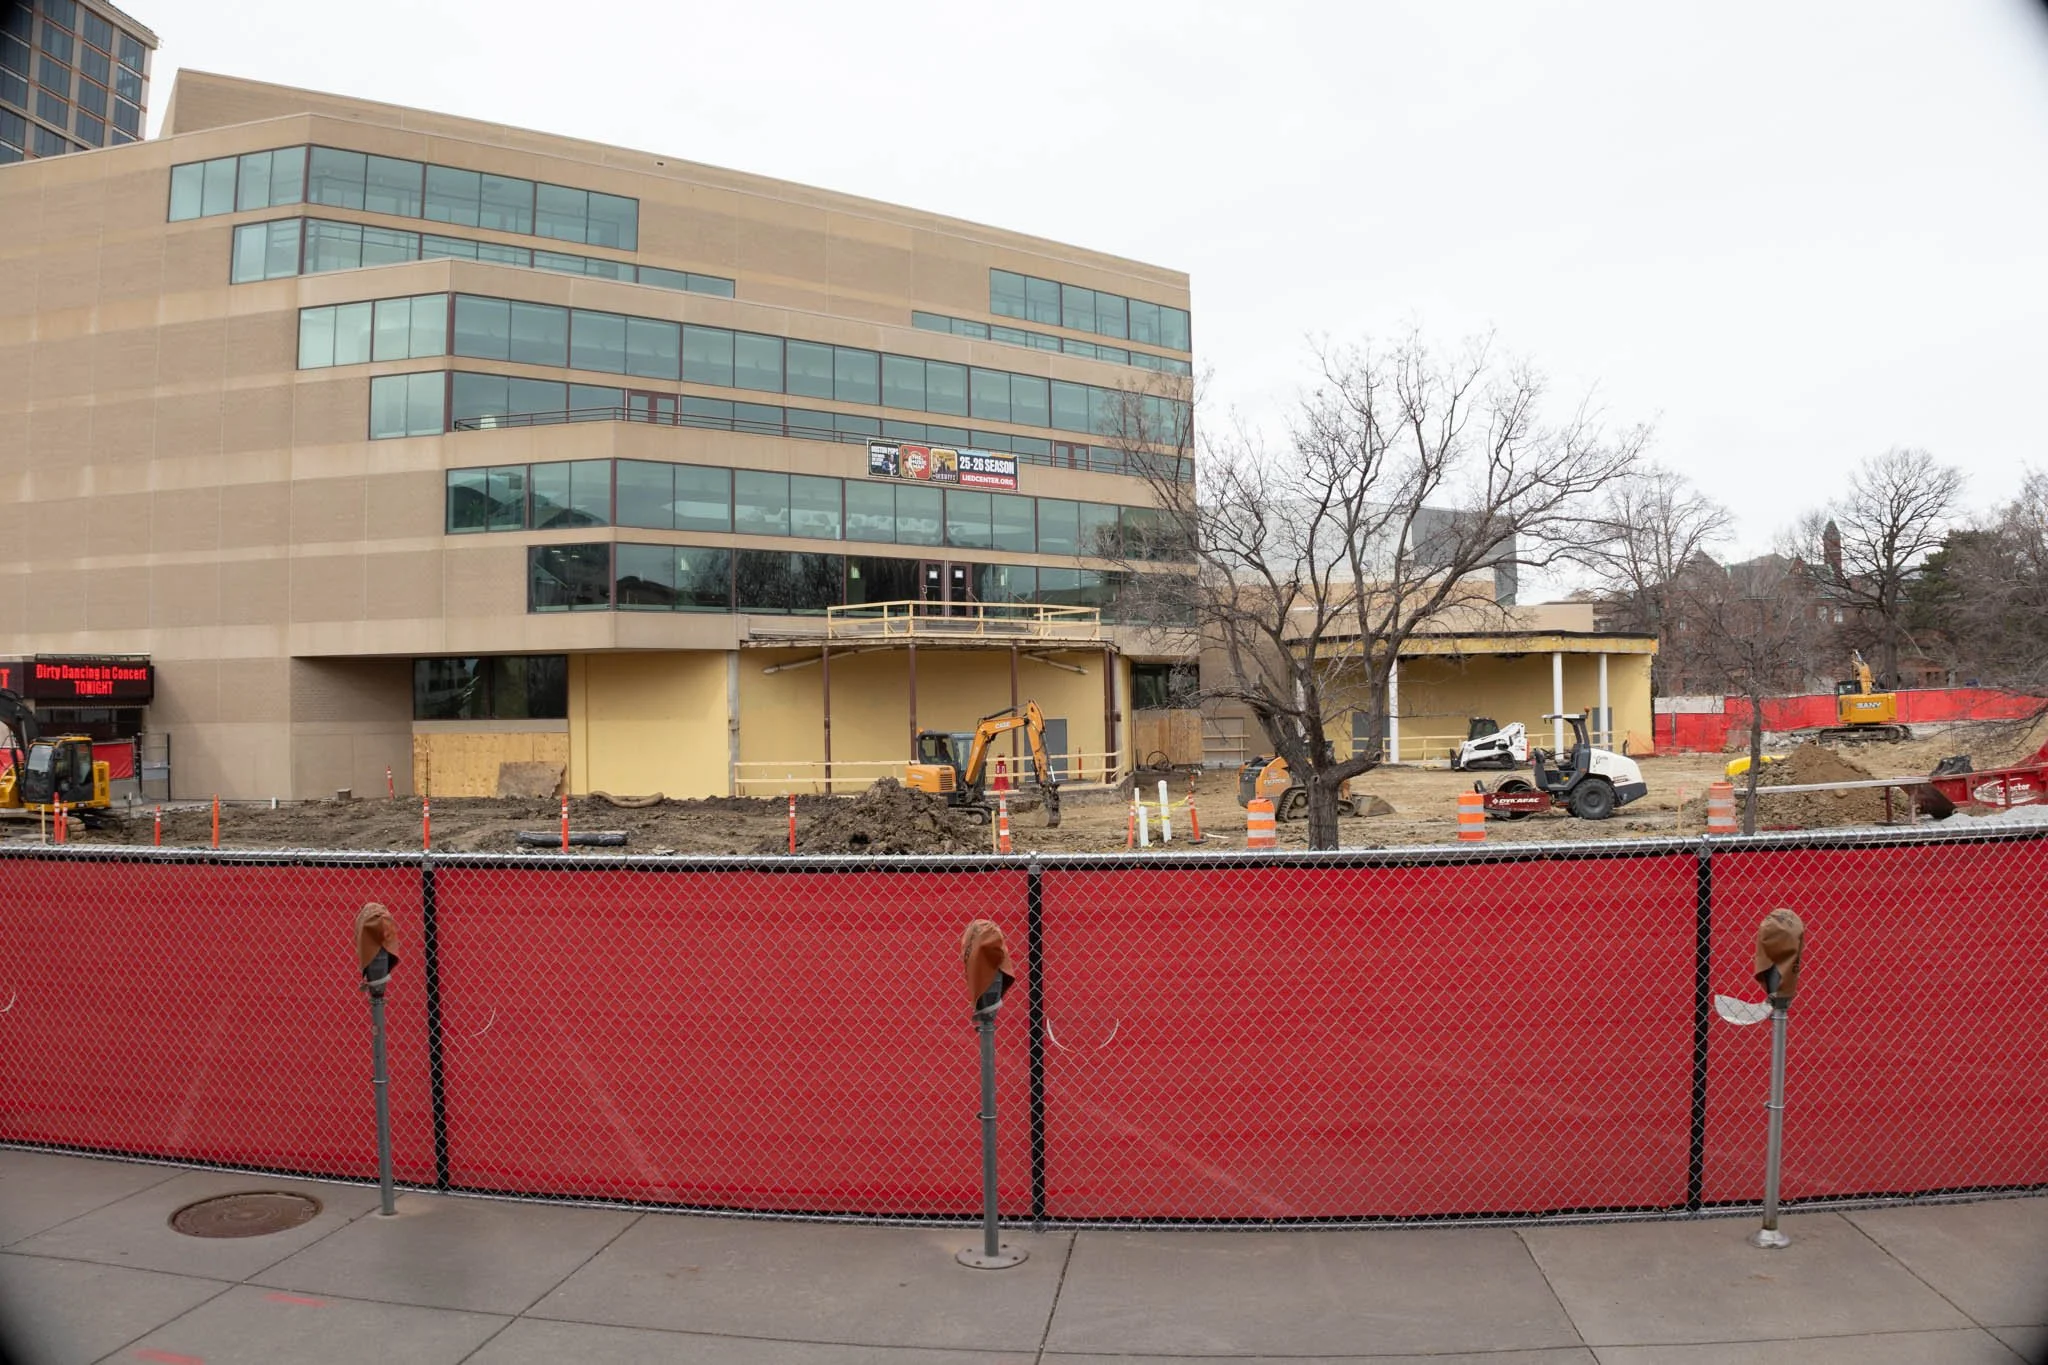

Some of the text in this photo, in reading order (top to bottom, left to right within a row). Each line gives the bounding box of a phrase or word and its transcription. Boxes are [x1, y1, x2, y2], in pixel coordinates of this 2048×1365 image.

[960, 456, 1014, 475] 25-26 SEASON
[962, 474, 1014, 485] LIEDCENTER.ORG
[36, 664, 61, 680] Dirty
[62, 665, 100, 681] Dancing
[111, 666, 147, 681] Concert
[74, 680, 114, 695] TONIGHT
